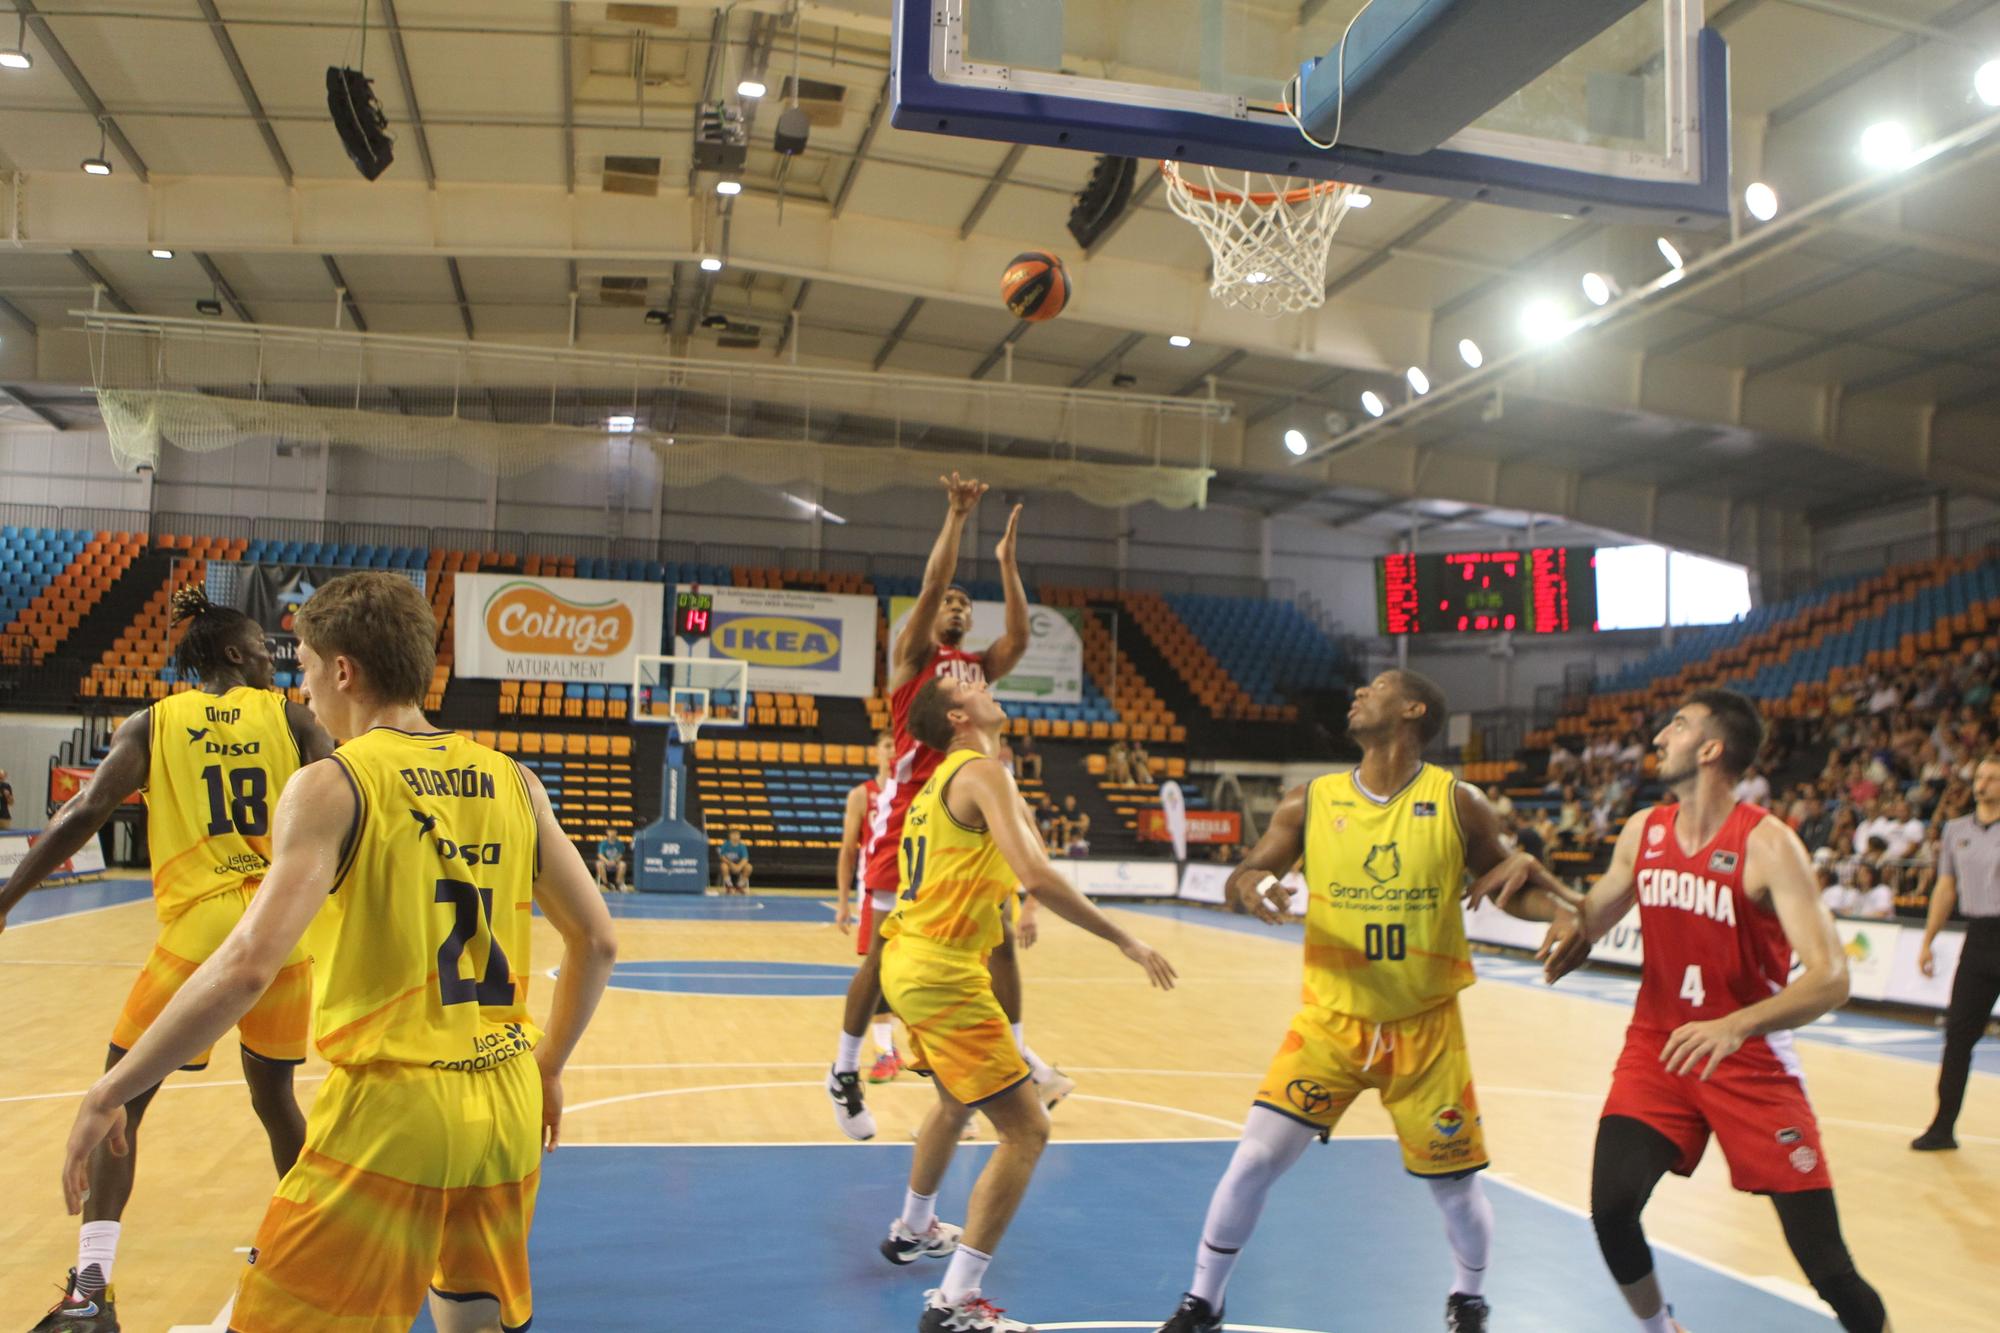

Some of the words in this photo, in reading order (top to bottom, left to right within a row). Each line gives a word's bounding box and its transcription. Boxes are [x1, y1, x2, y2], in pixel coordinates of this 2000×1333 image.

[499, 602, 620, 654] Coinga
[686, 610, 708, 632] 14
[723, 628, 830, 654] IKEA
[507, 658, 606, 679] NATURALMENT
[201, 764, 269, 836] 18
[400, 764, 496, 799] BORDÓN
[436, 838, 502, 866] DSA
[1637, 868, 1736, 928] GIRONA
[434, 879, 516, 1006] 21
[1365, 923, 1406, 961] 00
[1680, 964, 1706, 1007] 4
